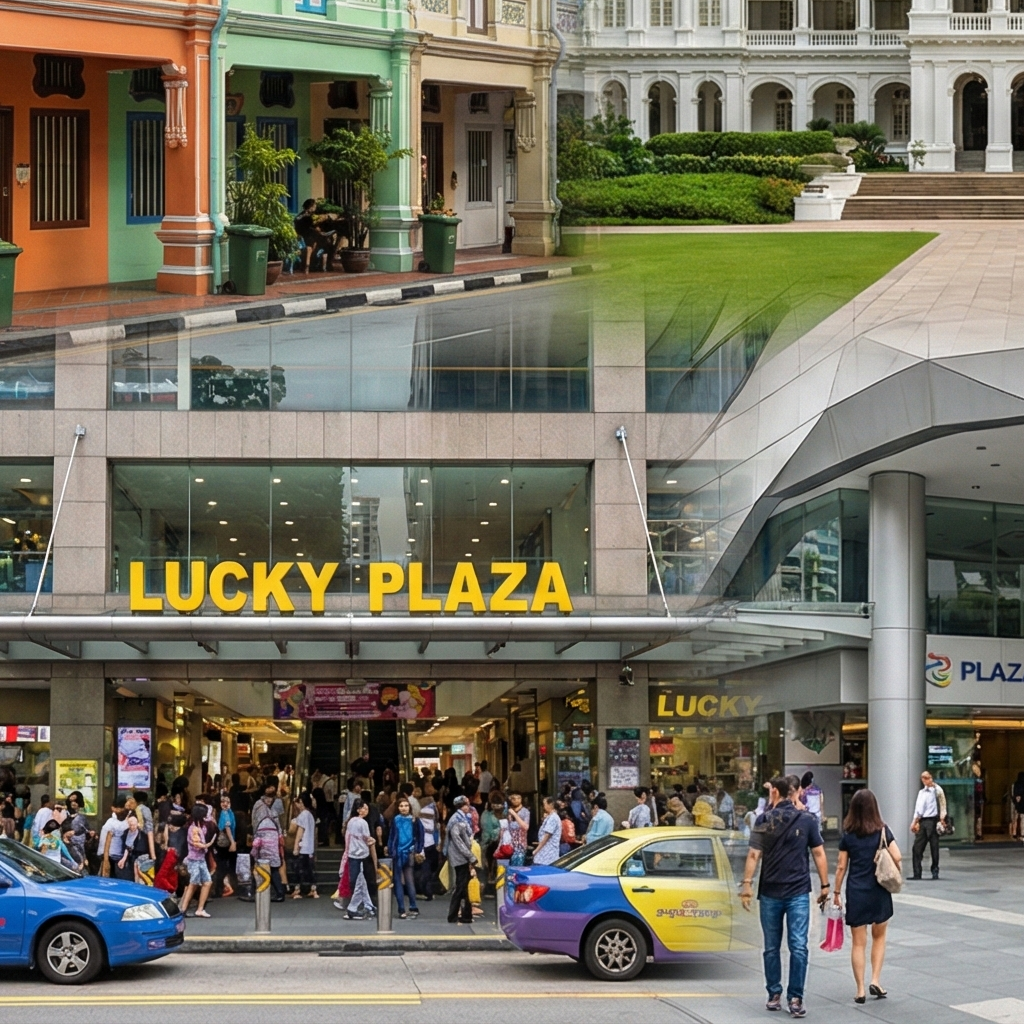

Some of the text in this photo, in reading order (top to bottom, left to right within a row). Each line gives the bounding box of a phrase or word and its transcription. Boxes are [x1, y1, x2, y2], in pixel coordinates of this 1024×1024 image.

[129, 561, 574, 613] LUCKY PLAZA
[657, 694, 763, 718] LUCKY
